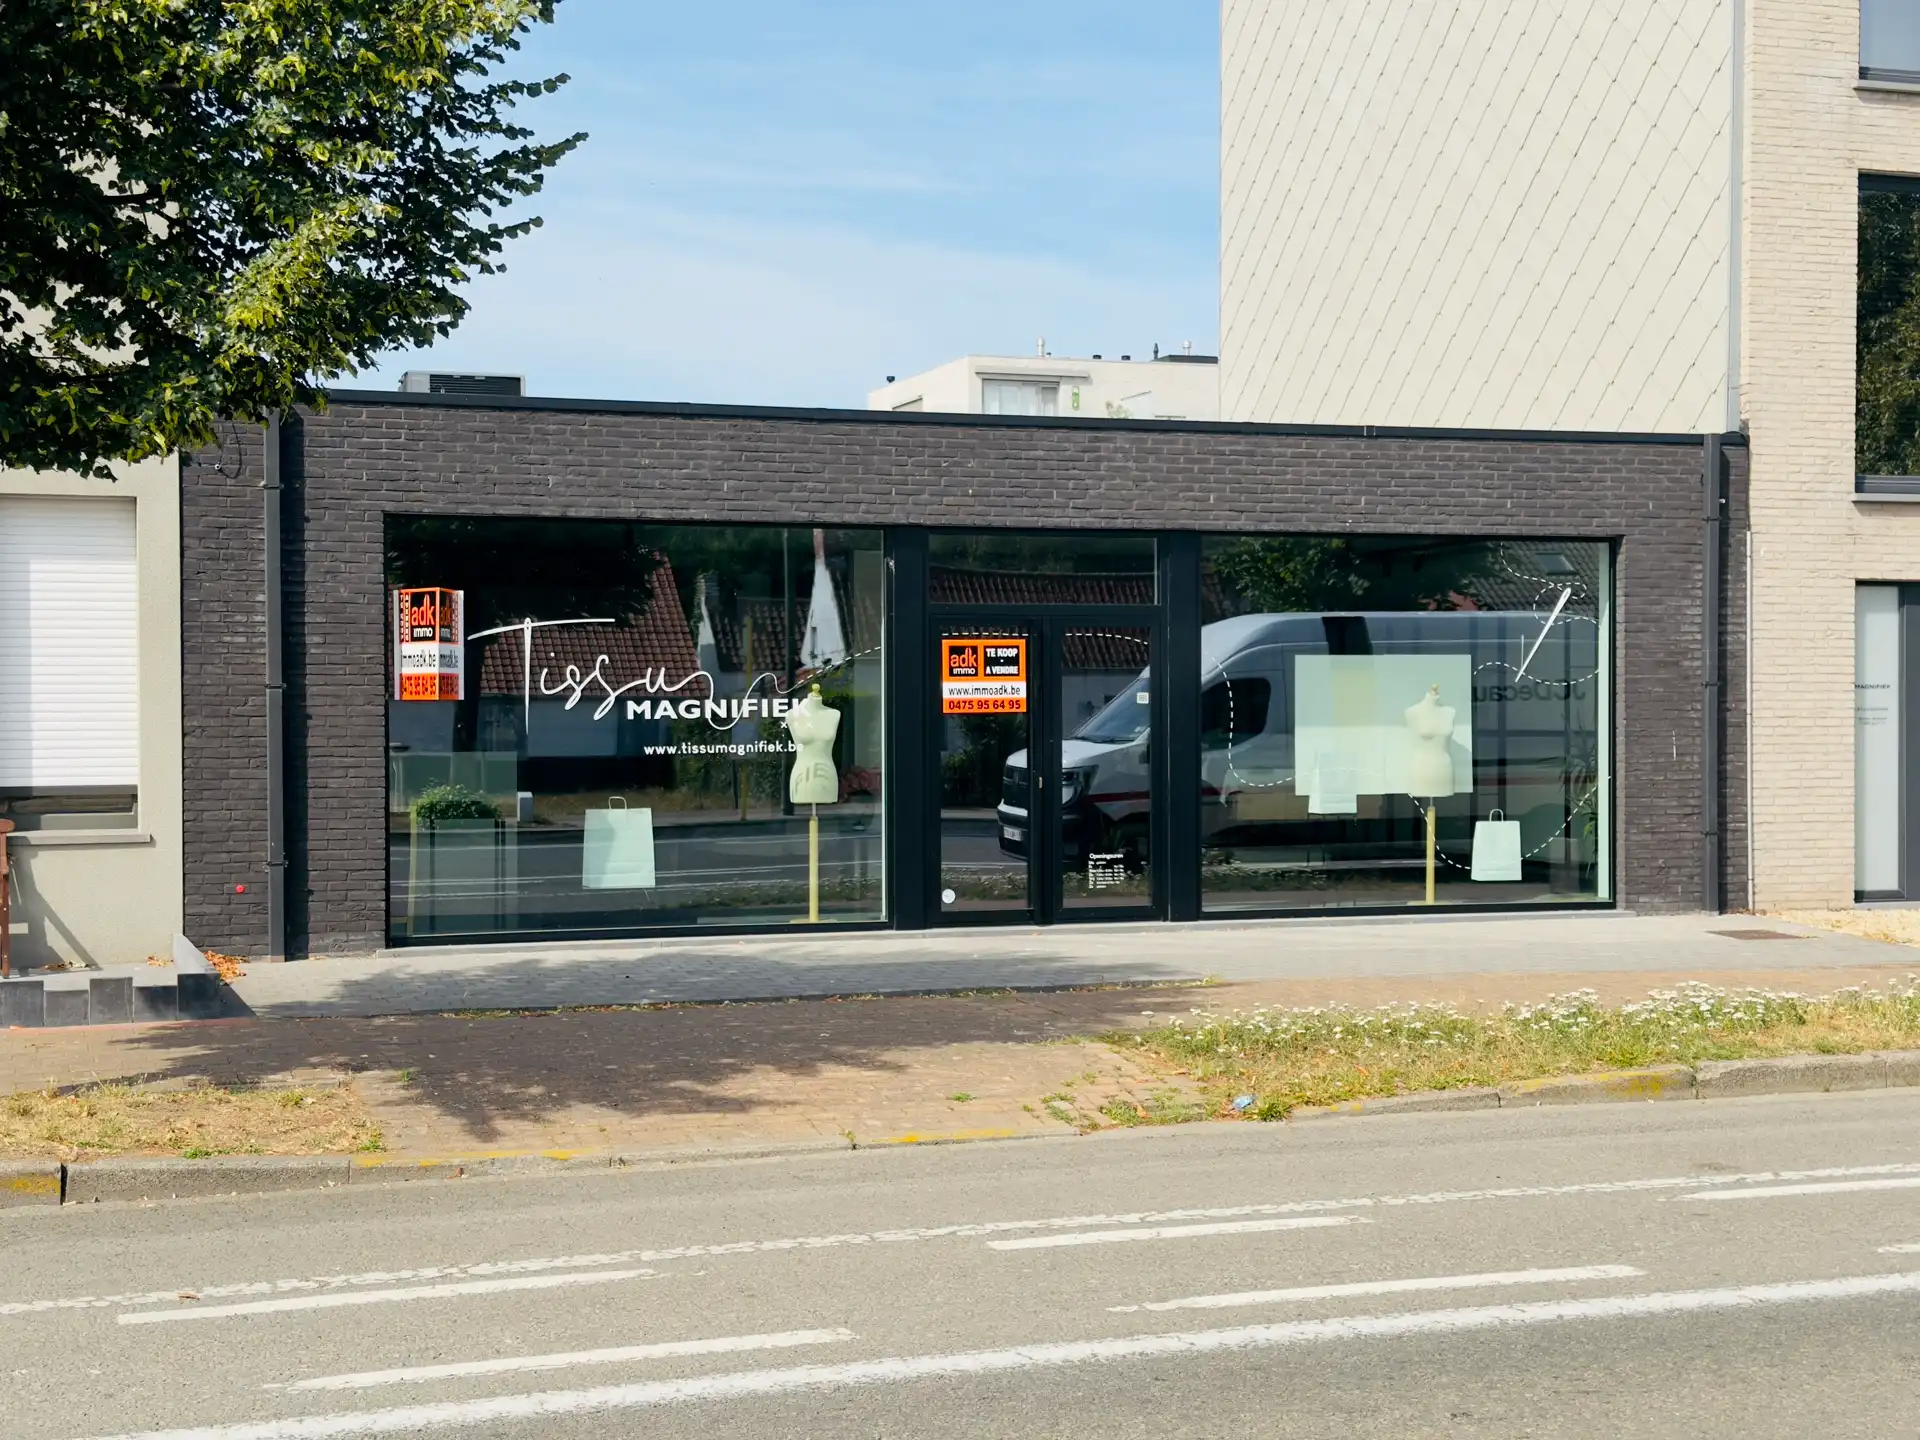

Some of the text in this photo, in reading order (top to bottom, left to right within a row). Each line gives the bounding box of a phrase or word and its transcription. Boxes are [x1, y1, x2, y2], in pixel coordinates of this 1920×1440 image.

[411, 593, 435, 626] adk
[413, 628, 433, 638] immo
[950, 647, 977, 667] adk
[986, 648, 1018, 657] TE KOOP
[467, 617, 714, 735] Tissu
[986, 666, 1018, 675] A VENDRE
[948, 685, 1021, 696] www.immoadk.be
[627, 698, 812, 720] MAGNIFIEK
[948, 701, 1021, 709] 0475 95 64 95
[644, 740, 804, 756] www.tissumagnifiek.be
